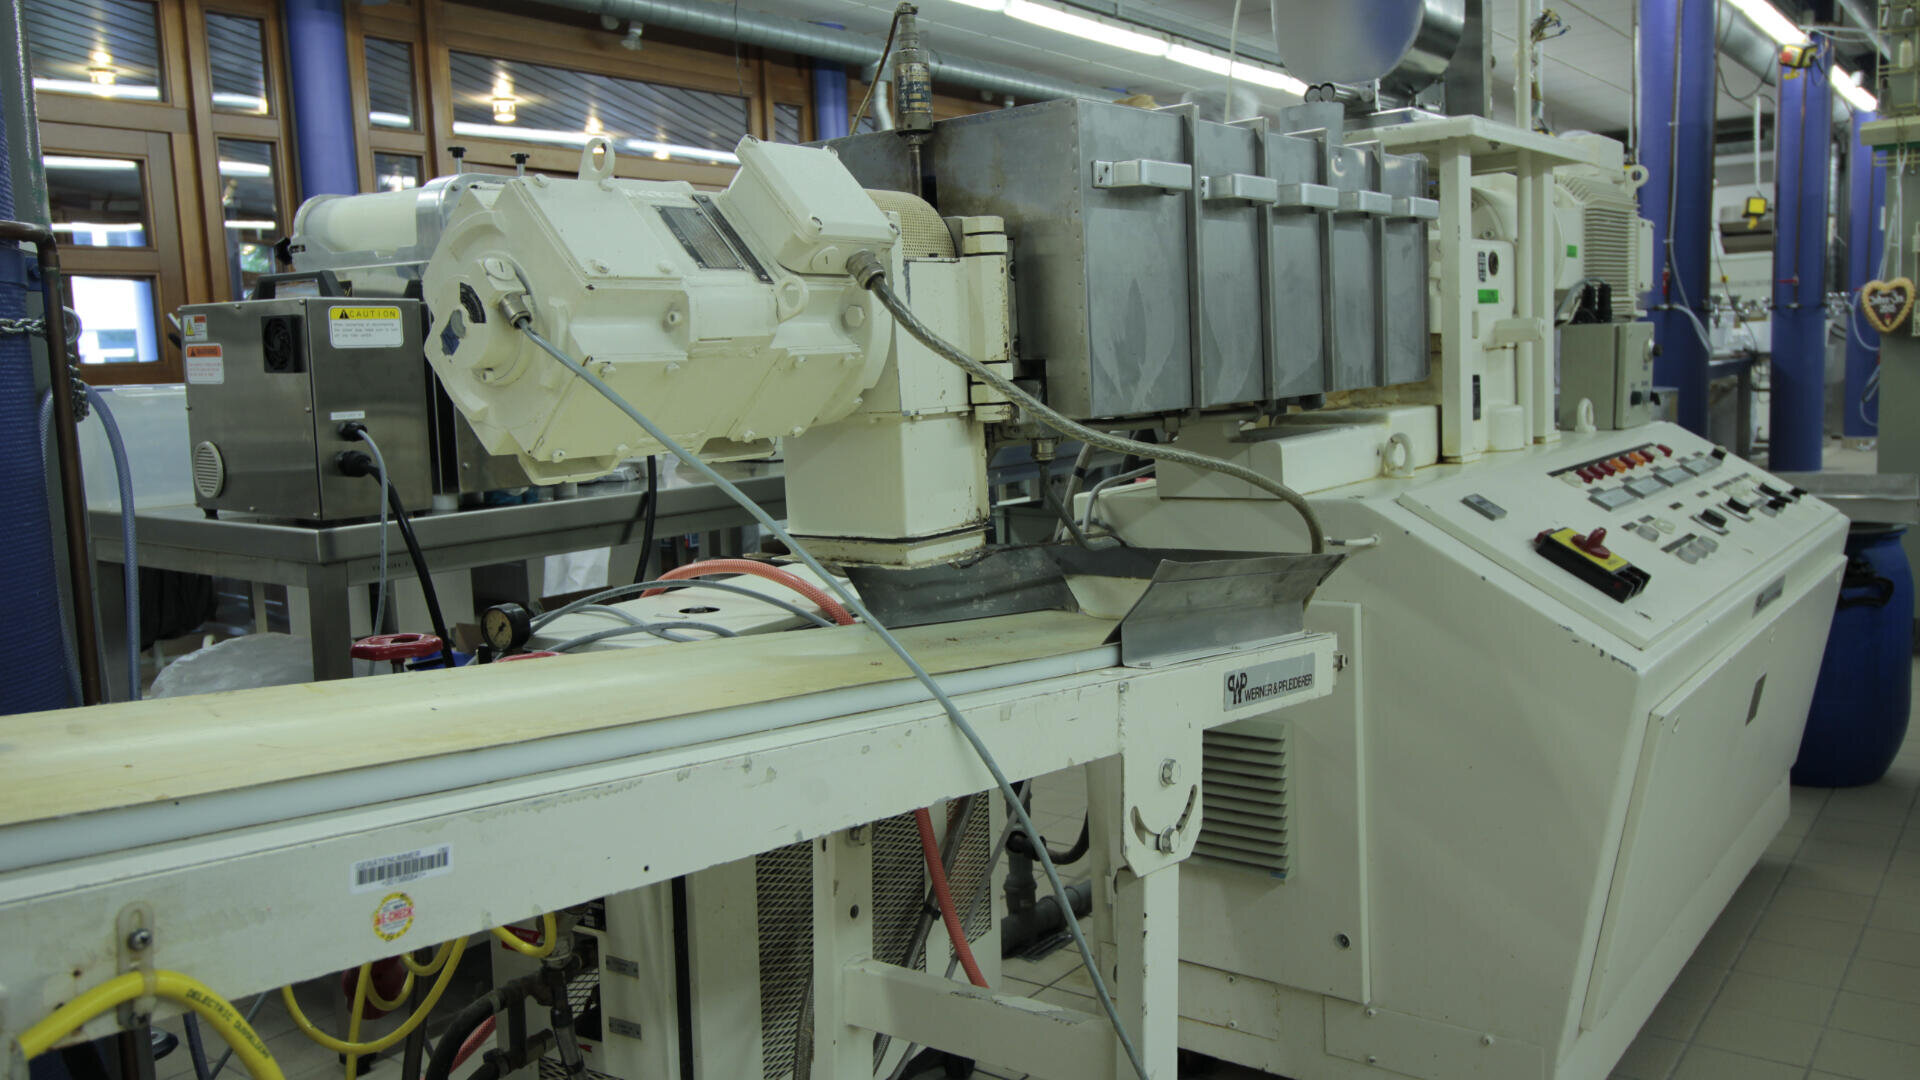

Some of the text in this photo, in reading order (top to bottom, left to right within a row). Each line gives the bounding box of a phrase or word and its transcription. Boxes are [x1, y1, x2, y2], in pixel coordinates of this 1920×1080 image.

[349, 310, 396, 319] CAUTION
[1245, 673, 1312, 702] WERNER & PFLEIDERER
